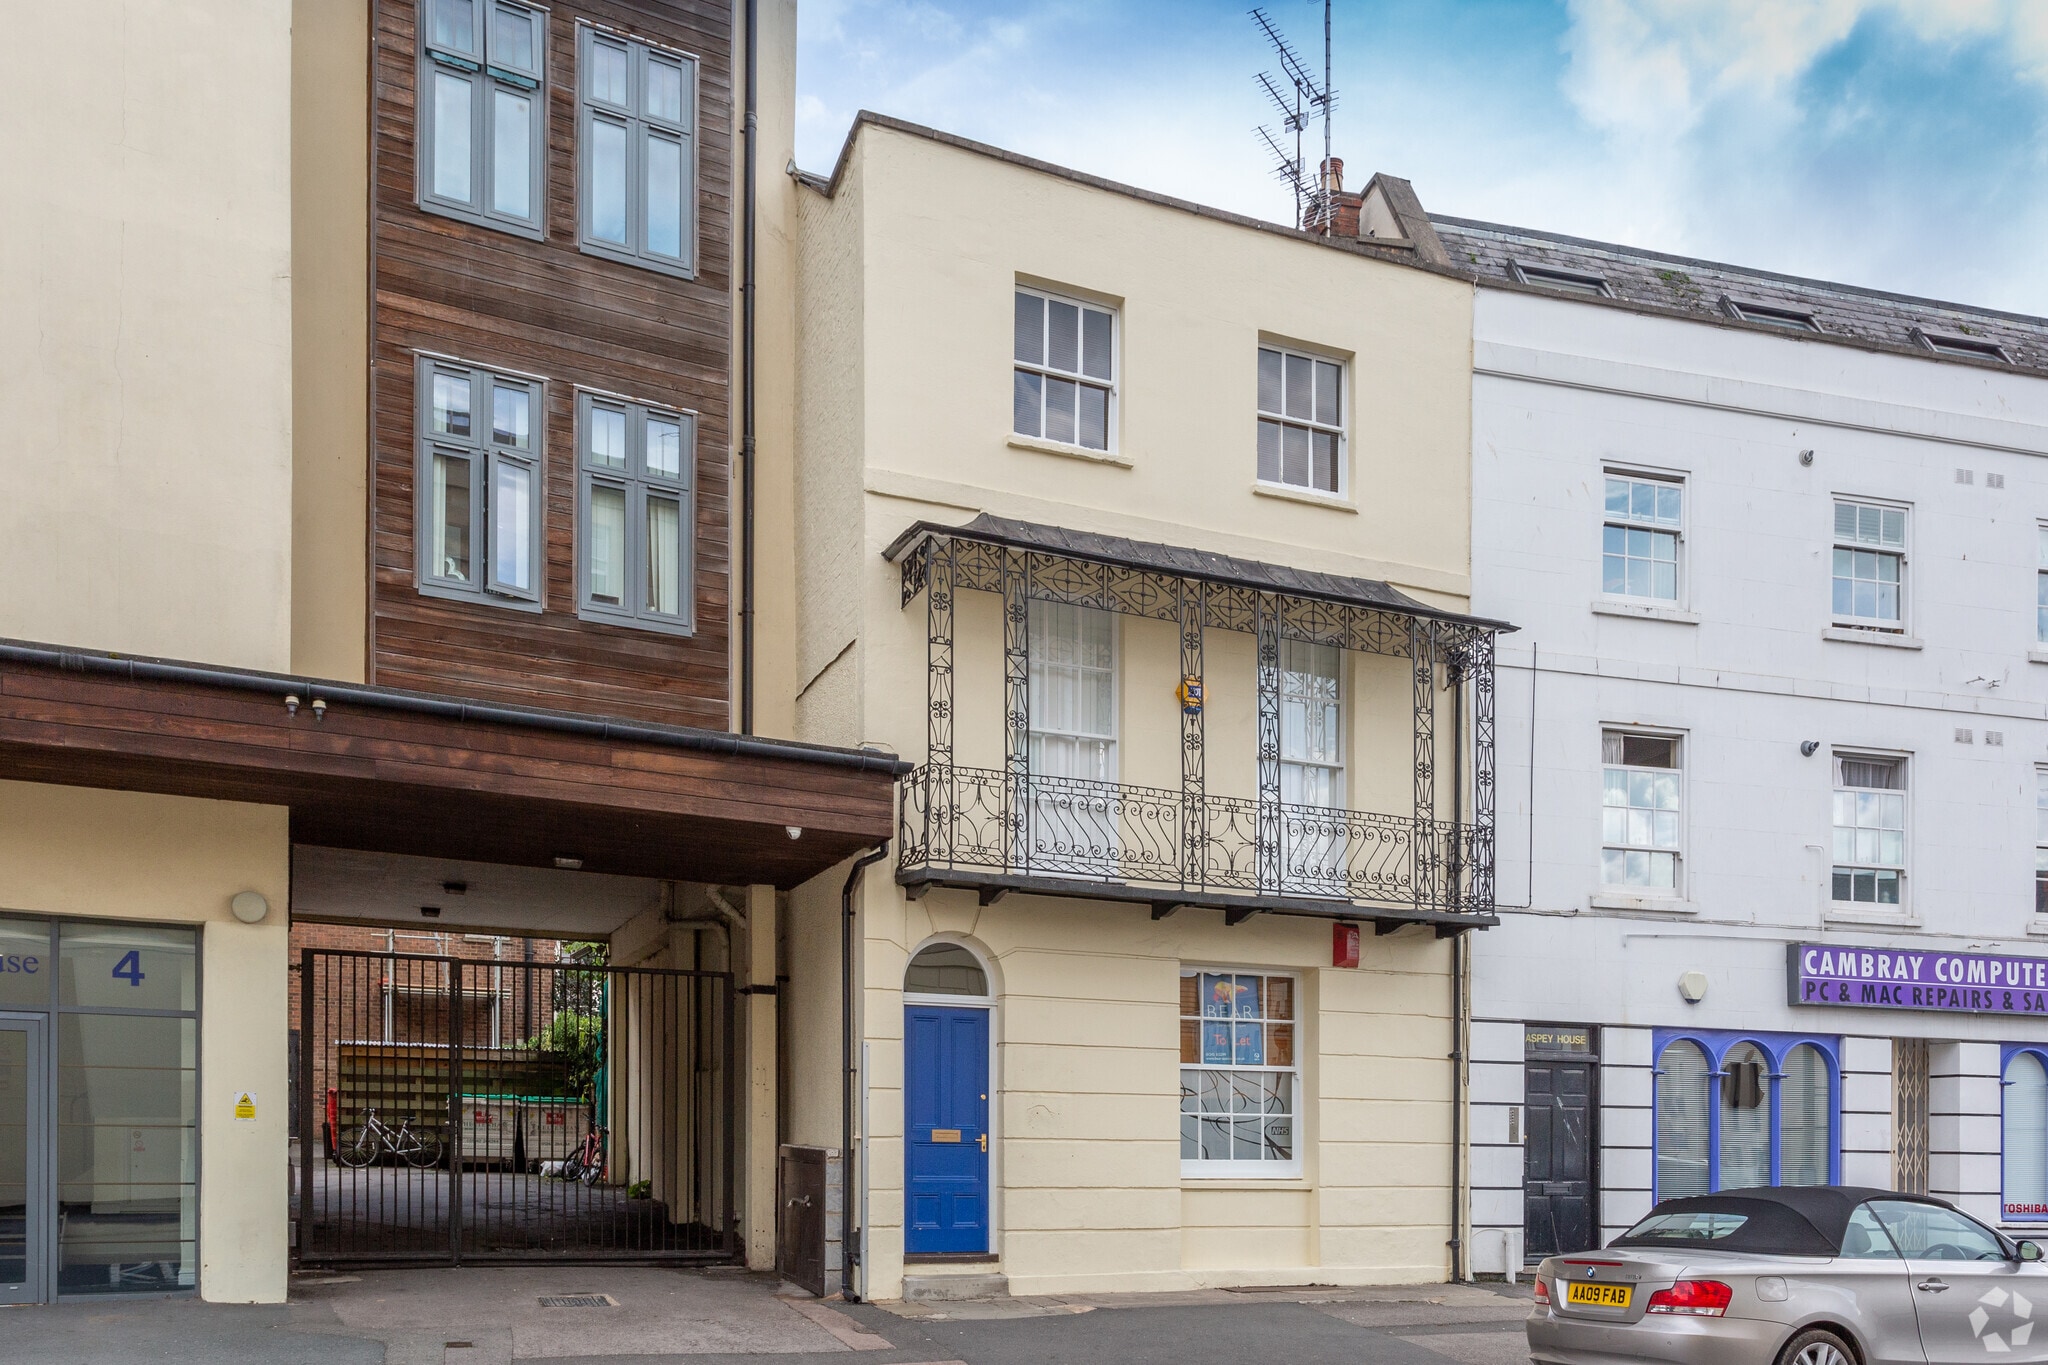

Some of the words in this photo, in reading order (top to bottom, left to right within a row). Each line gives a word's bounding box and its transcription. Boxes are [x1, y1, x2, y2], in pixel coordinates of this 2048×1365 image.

[0, 954, 39, 974] se
[112, 950, 145, 987] 4
[1804, 950, 1924, 980] CAMBRAY
[1935, 957, 2046, 987] COMPUTE
[1805, 981, 1829, 1001] PC
[1839, 984, 1851, 1002] &
[1861, 984, 1903, 1005] MAC
[1912, 986, 1993, 1010] REPAIRS
[2002, 990, 2014, 1010] &
[2023, 991, 2046, 1012] SA
[1207, 1004, 1253, 1019] BEAR
[1213, 1033, 1227, 1046] To
[1525, 1033, 1554, 1044] ASPEY
[1557, 1034, 1586, 1045] HOUSE
[1271, 1127, 1289, 1135] NHS
[2003, 1203, 2048, 1214] TOSHIBA
[1572, 1287, 1600, 1302] AA09
[1602, 1289, 1625, 1304] FAB
